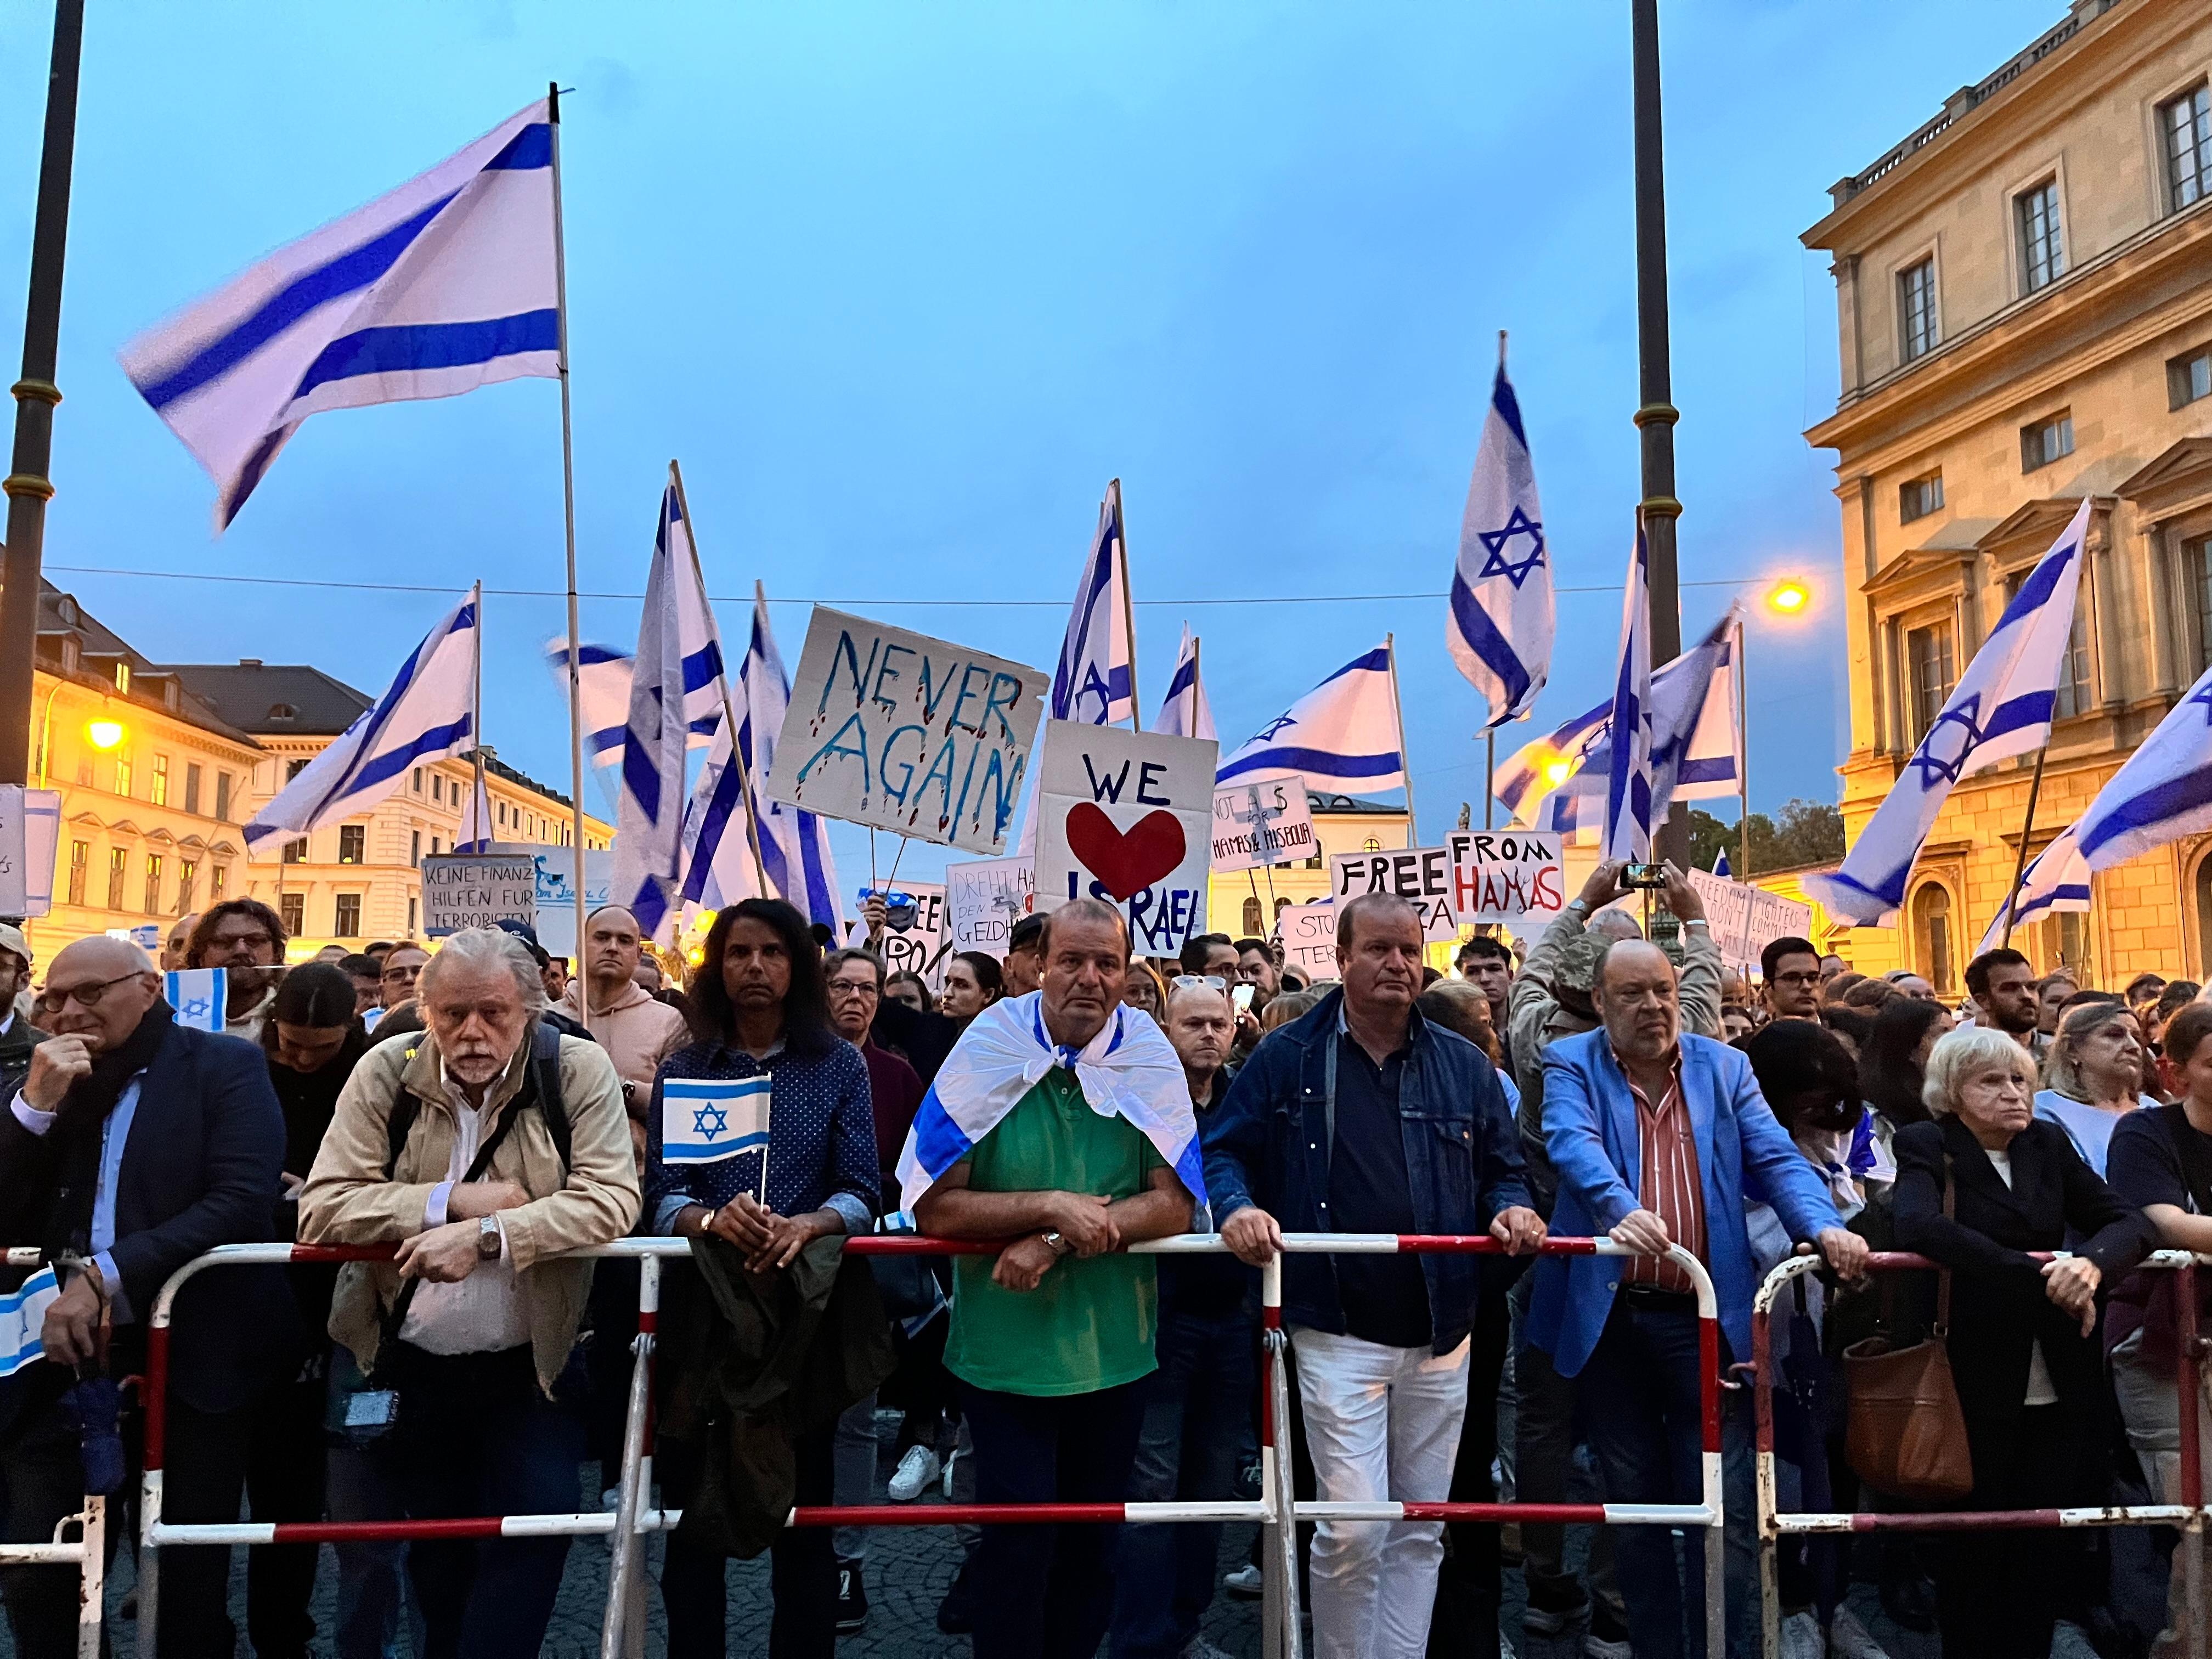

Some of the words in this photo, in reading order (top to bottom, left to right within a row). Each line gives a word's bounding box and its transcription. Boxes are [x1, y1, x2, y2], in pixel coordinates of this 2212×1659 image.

[817, 630, 1022, 749] NEVER
[797, 712, 1023, 844] AGAIN
[1082, 754, 1170, 805] WE
[1452, 836, 1554, 864] FROM
[425, 866, 475, 885] KEINE
[954, 871, 1008, 904] DREHT
[1340, 851, 1447, 897] FREE
[432, 888, 491, 907] HILFEN
[1454, 865, 1562, 914] HAMAS
[1694, 877, 1747, 911] FREEDOM
[958, 904, 986, 919] DEN
[1296, 915, 1335, 938] STO
[1412, 898, 1454, 930] ZA
[1713, 927, 1739, 951] WAR
[1752, 916, 1787, 939] COMMIT
[1293, 944, 1337, 966] TER
